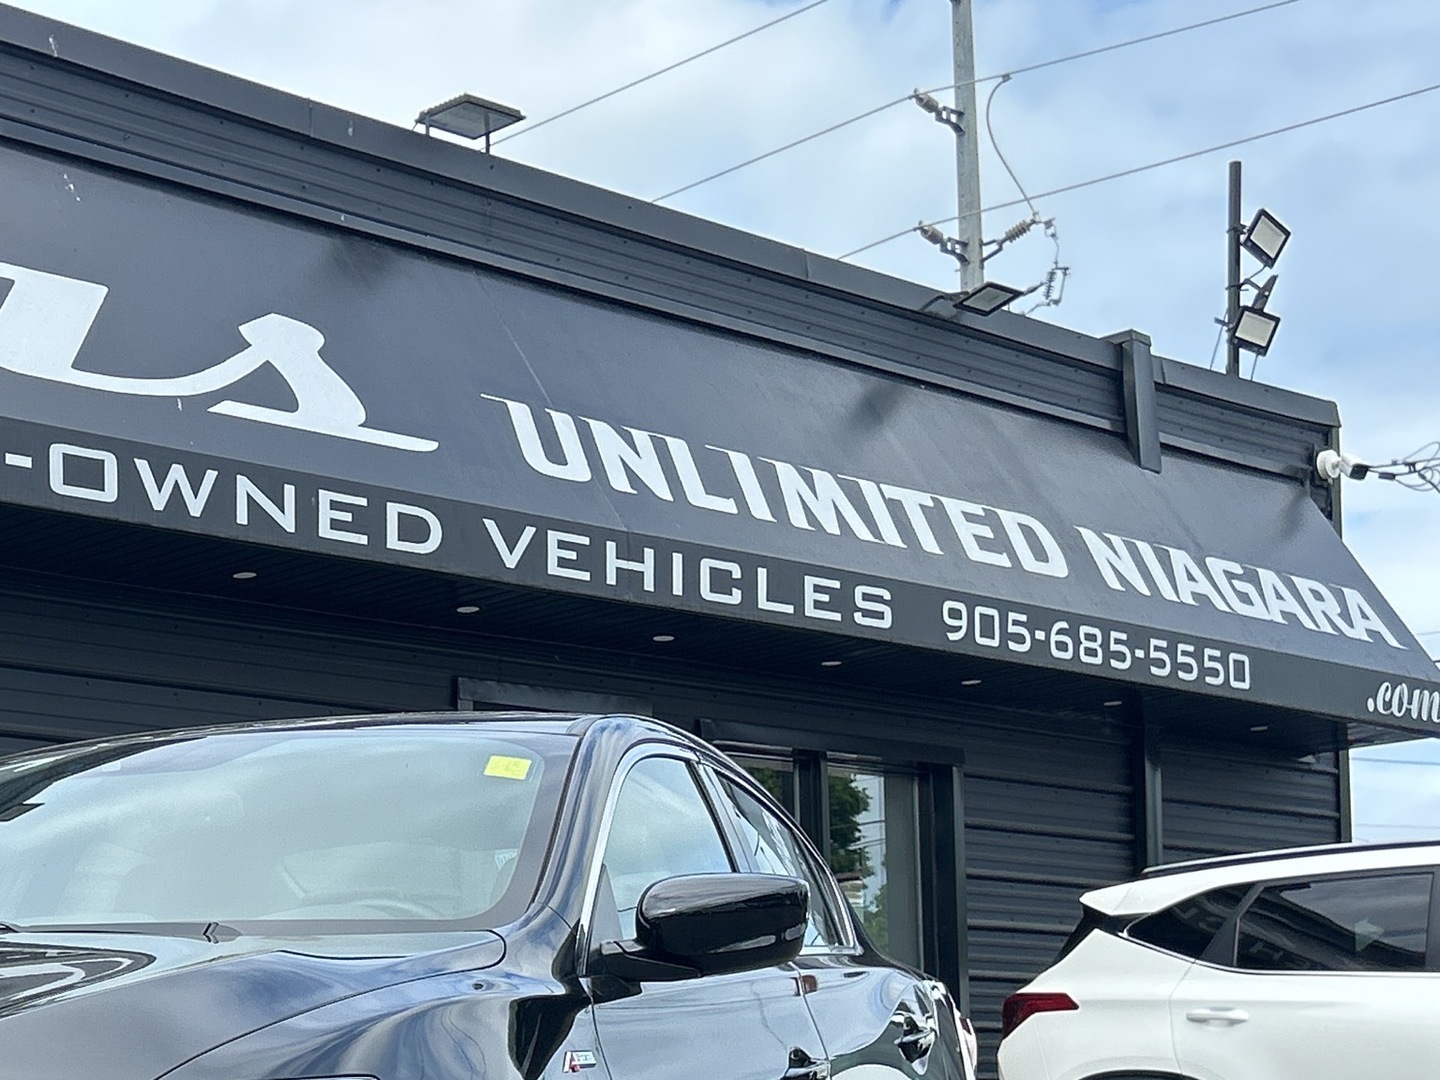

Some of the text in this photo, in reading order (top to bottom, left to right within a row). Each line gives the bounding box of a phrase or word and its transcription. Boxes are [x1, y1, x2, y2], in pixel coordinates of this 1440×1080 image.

[480, 393, 1409, 649] UNLIMITED NIAGARA
[481, 518, 893, 629] VEHICLES
[942, 600, 1252, 690] 905-685-5550
[1367, 681, 1440, 723] .com
